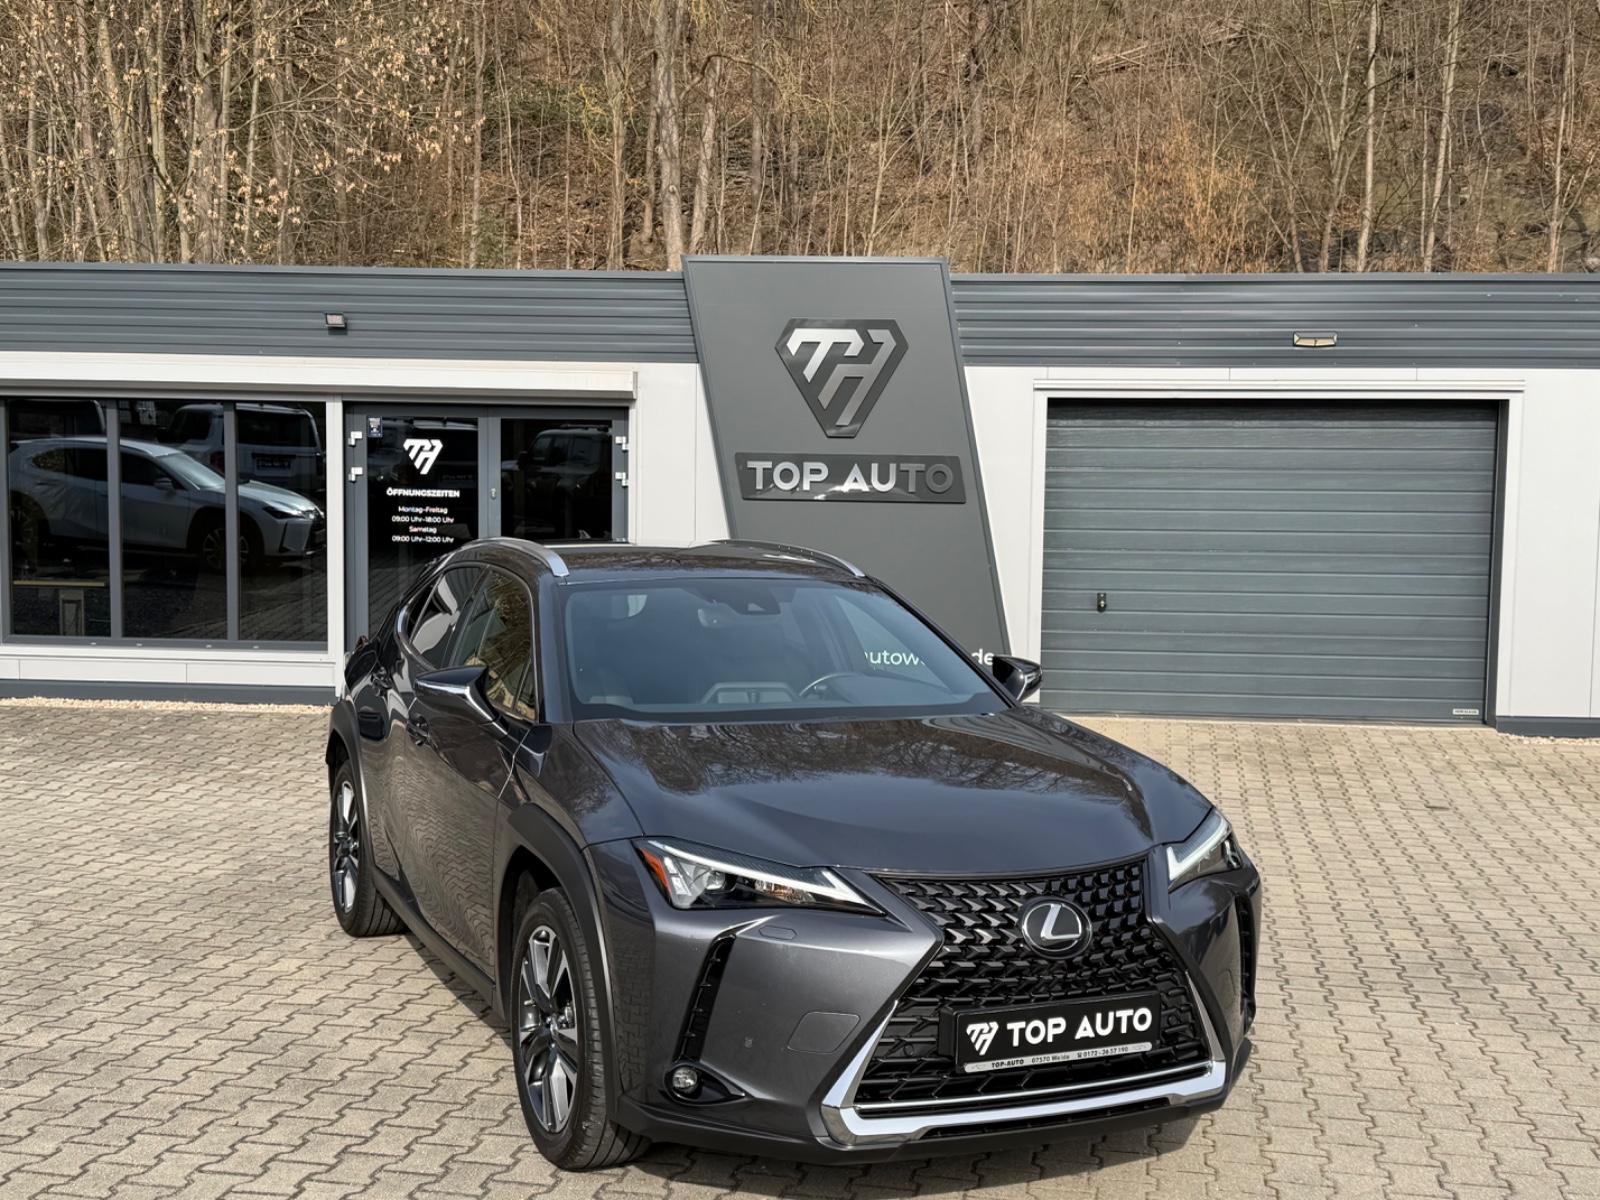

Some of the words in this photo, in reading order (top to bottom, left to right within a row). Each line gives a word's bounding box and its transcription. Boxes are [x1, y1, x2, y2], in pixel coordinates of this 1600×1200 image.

[747, 461, 829, 491] TOP
[841, 463, 954, 493] AUTO
[386, 487, 460, 498] ÖFFNUNGSZEITEN
[1006, 1017, 1067, 1047] TOP
[1074, 1007, 1152, 1040] AUTO
[991, 1059, 1025, 1069] TOP-AUTO
